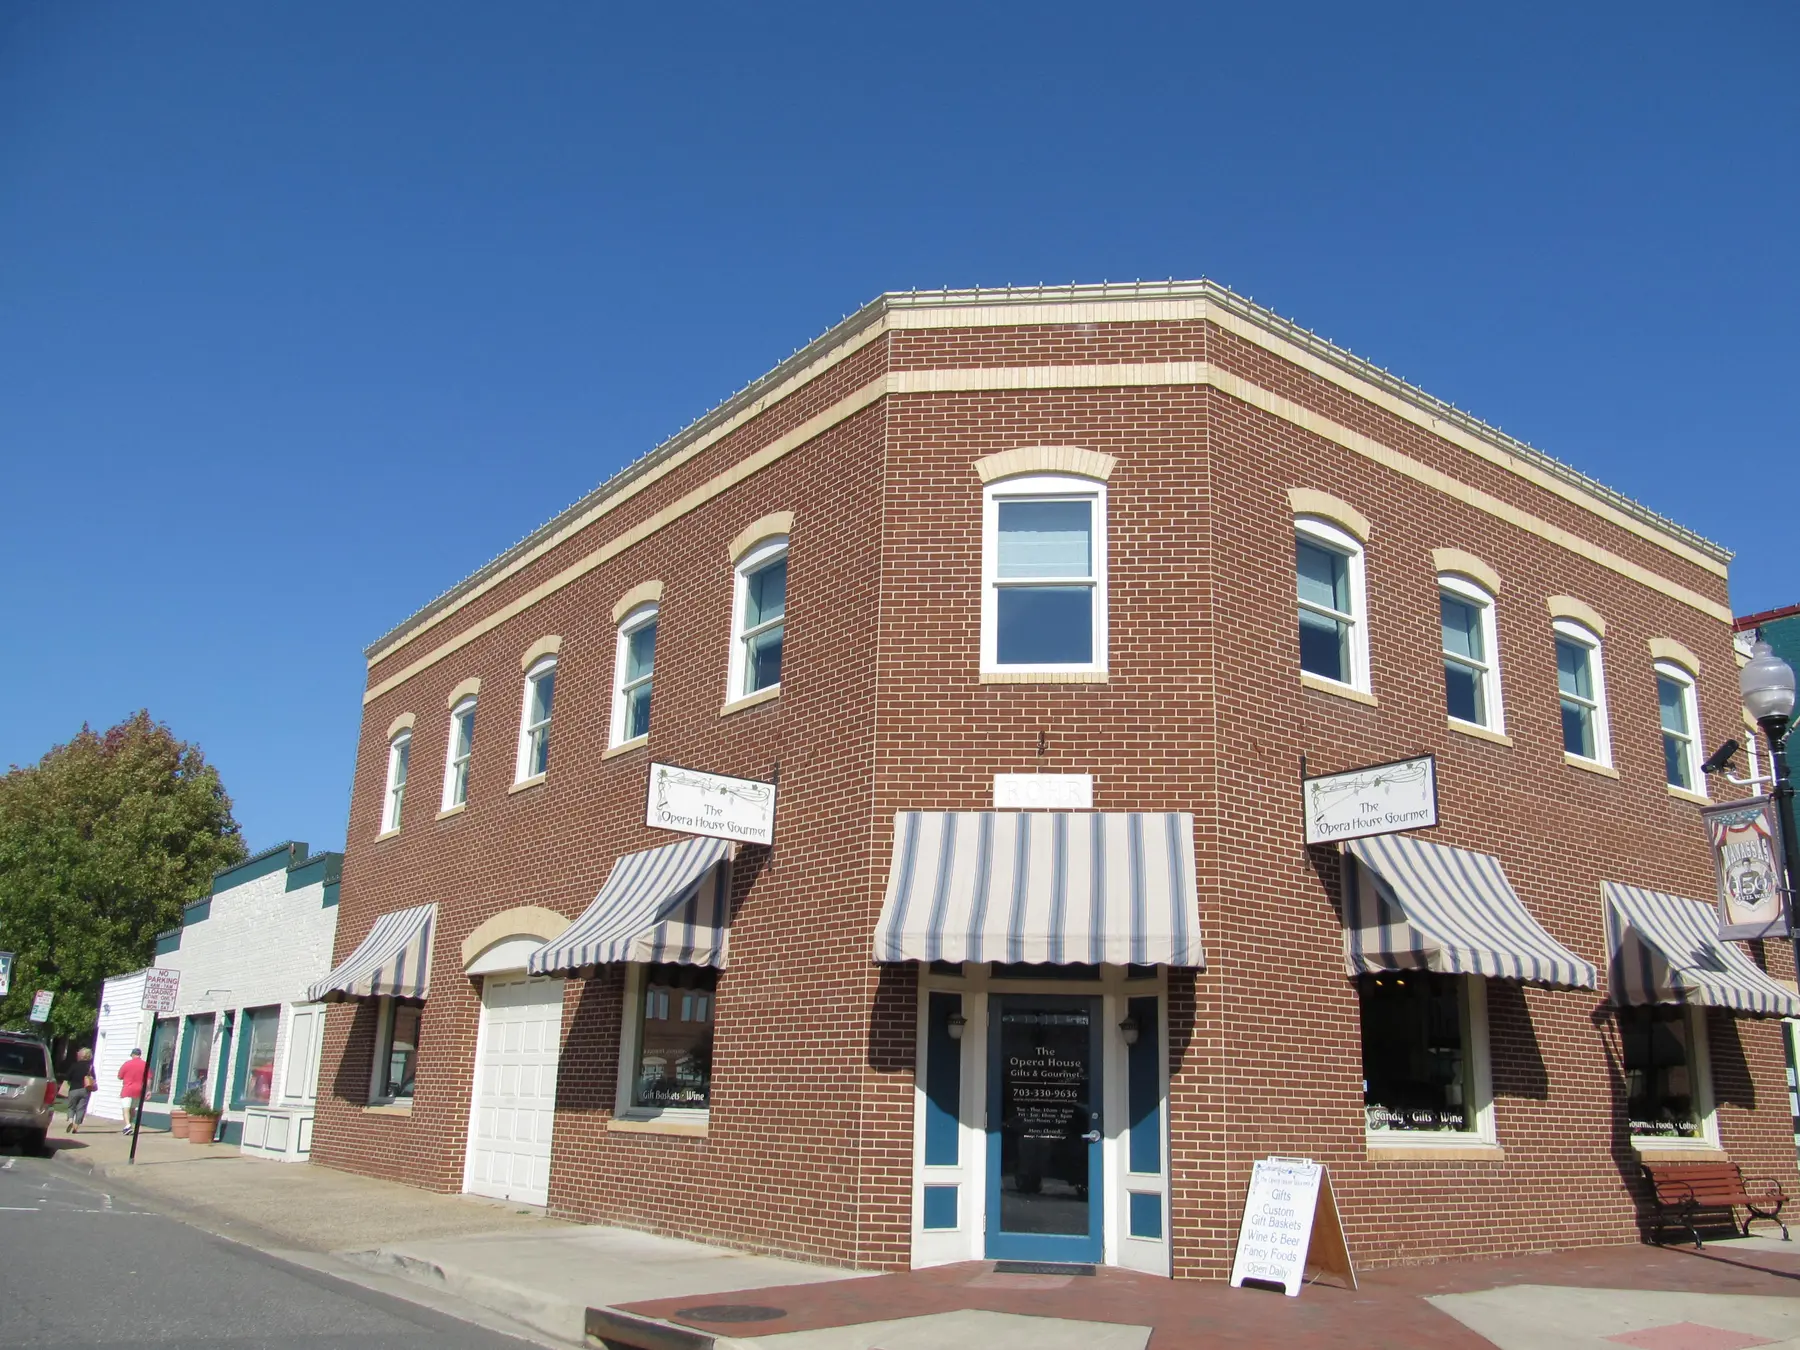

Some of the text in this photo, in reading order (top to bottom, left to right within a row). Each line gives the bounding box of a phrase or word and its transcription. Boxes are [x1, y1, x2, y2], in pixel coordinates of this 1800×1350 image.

[704, 803, 723, 817] The
[1359, 802, 1379, 814] The
[661, 811, 766, 838] Opera House Gourmet
[1319, 808, 1428, 836] Opera House Gourmet
[1721, 838, 1770, 867] MANASSAS
[148, 976, 178, 984] PARKING
[1035, 1047, 1055, 1056] The
[1010, 1057, 1081, 1067] Opera House
[1010, 1069, 1030, 1077] Gifts
[1041, 1070, 1080, 1078] Gourmet
[642, 1089, 704, 1101] Gift Baskets Wine
[1374, 1109, 1463, 1125] Candy Gifts Wine
[1271, 1188, 1291, 1201] Gifts
[1262, 1203, 1294, 1218] Custom
[1251, 1214, 1301, 1231] Gift Baskets
[1248, 1229, 1268, 1242] Wine
[1280, 1232, 1300, 1246] Beer
[1243, 1244, 1297, 1262] Fancy Foods
[1247, 1262, 1288, 1280] Open Daily
